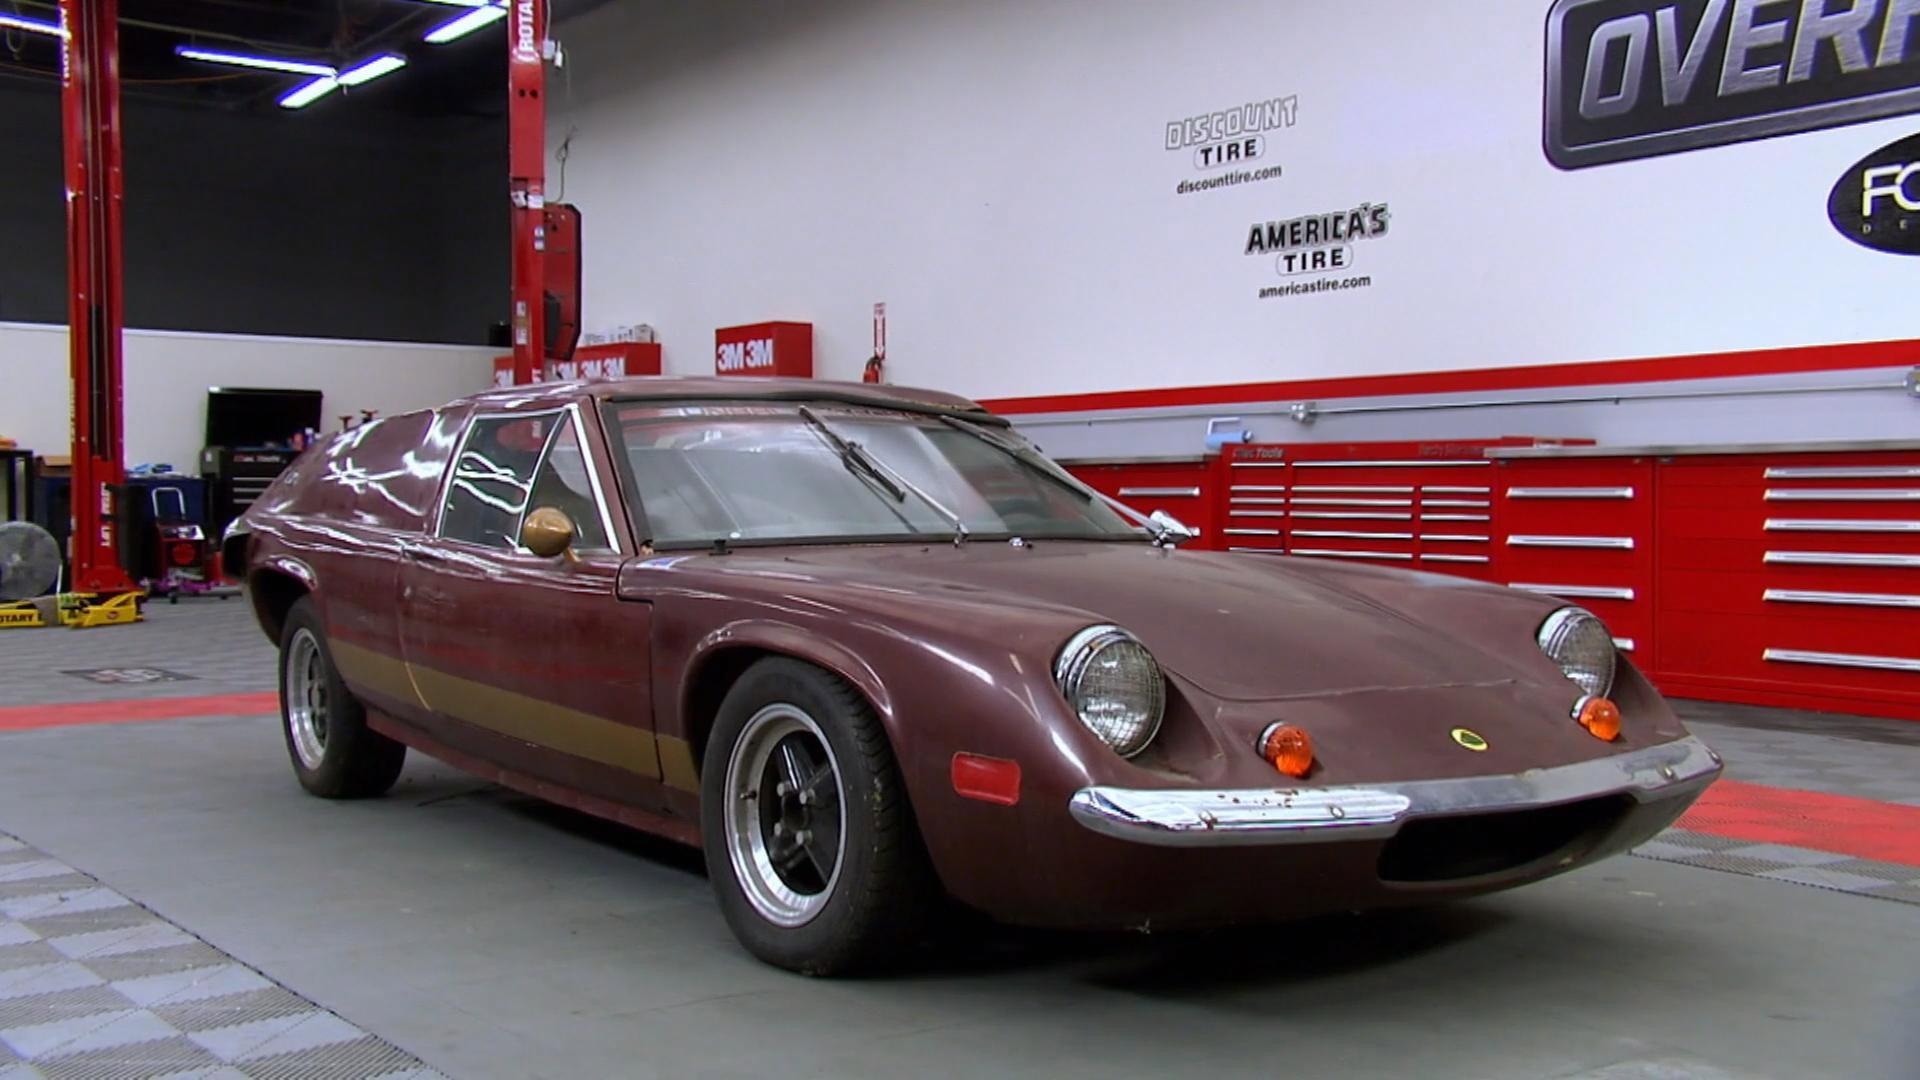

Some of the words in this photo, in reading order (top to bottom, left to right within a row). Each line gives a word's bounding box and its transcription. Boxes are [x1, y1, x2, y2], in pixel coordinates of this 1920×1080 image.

[1165, 94, 1298, 150] DISCOUNT
[1200, 138, 1257, 166] TIRE
[1176, 165, 1283, 194] discounttire.com
[1244, 202, 1388, 255] AMERICA'S
[1283, 247, 1343, 272] TIRE
[1259, 276, 1371, 299] americastire.com
[717, 342, 745, 372] 3M
[745, 338, 773, 368] 3M
